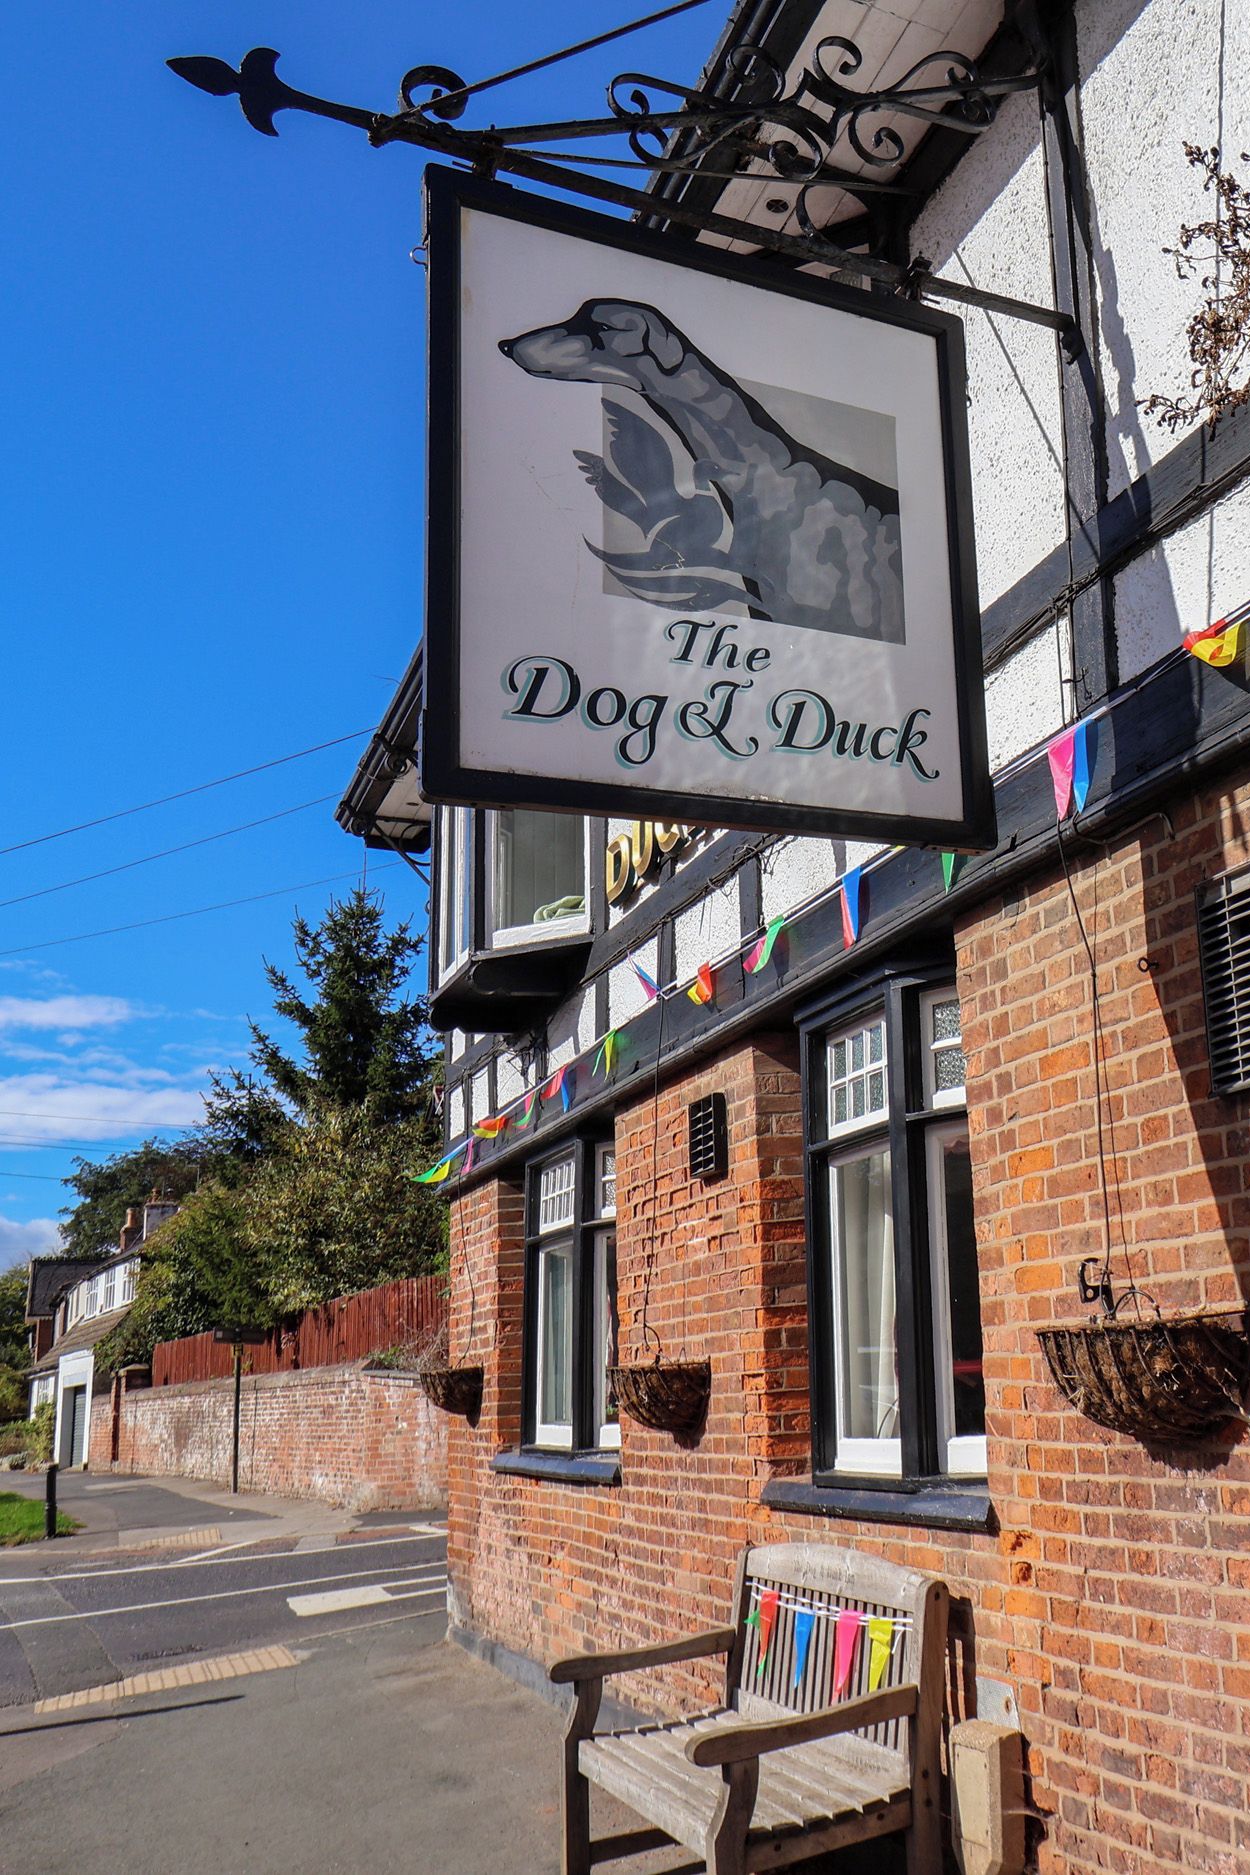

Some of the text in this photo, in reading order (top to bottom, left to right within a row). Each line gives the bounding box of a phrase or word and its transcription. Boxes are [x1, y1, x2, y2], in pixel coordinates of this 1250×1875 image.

[666, 618, 772, 672] The
[504, 655, 941, 783] Dog & Duck
